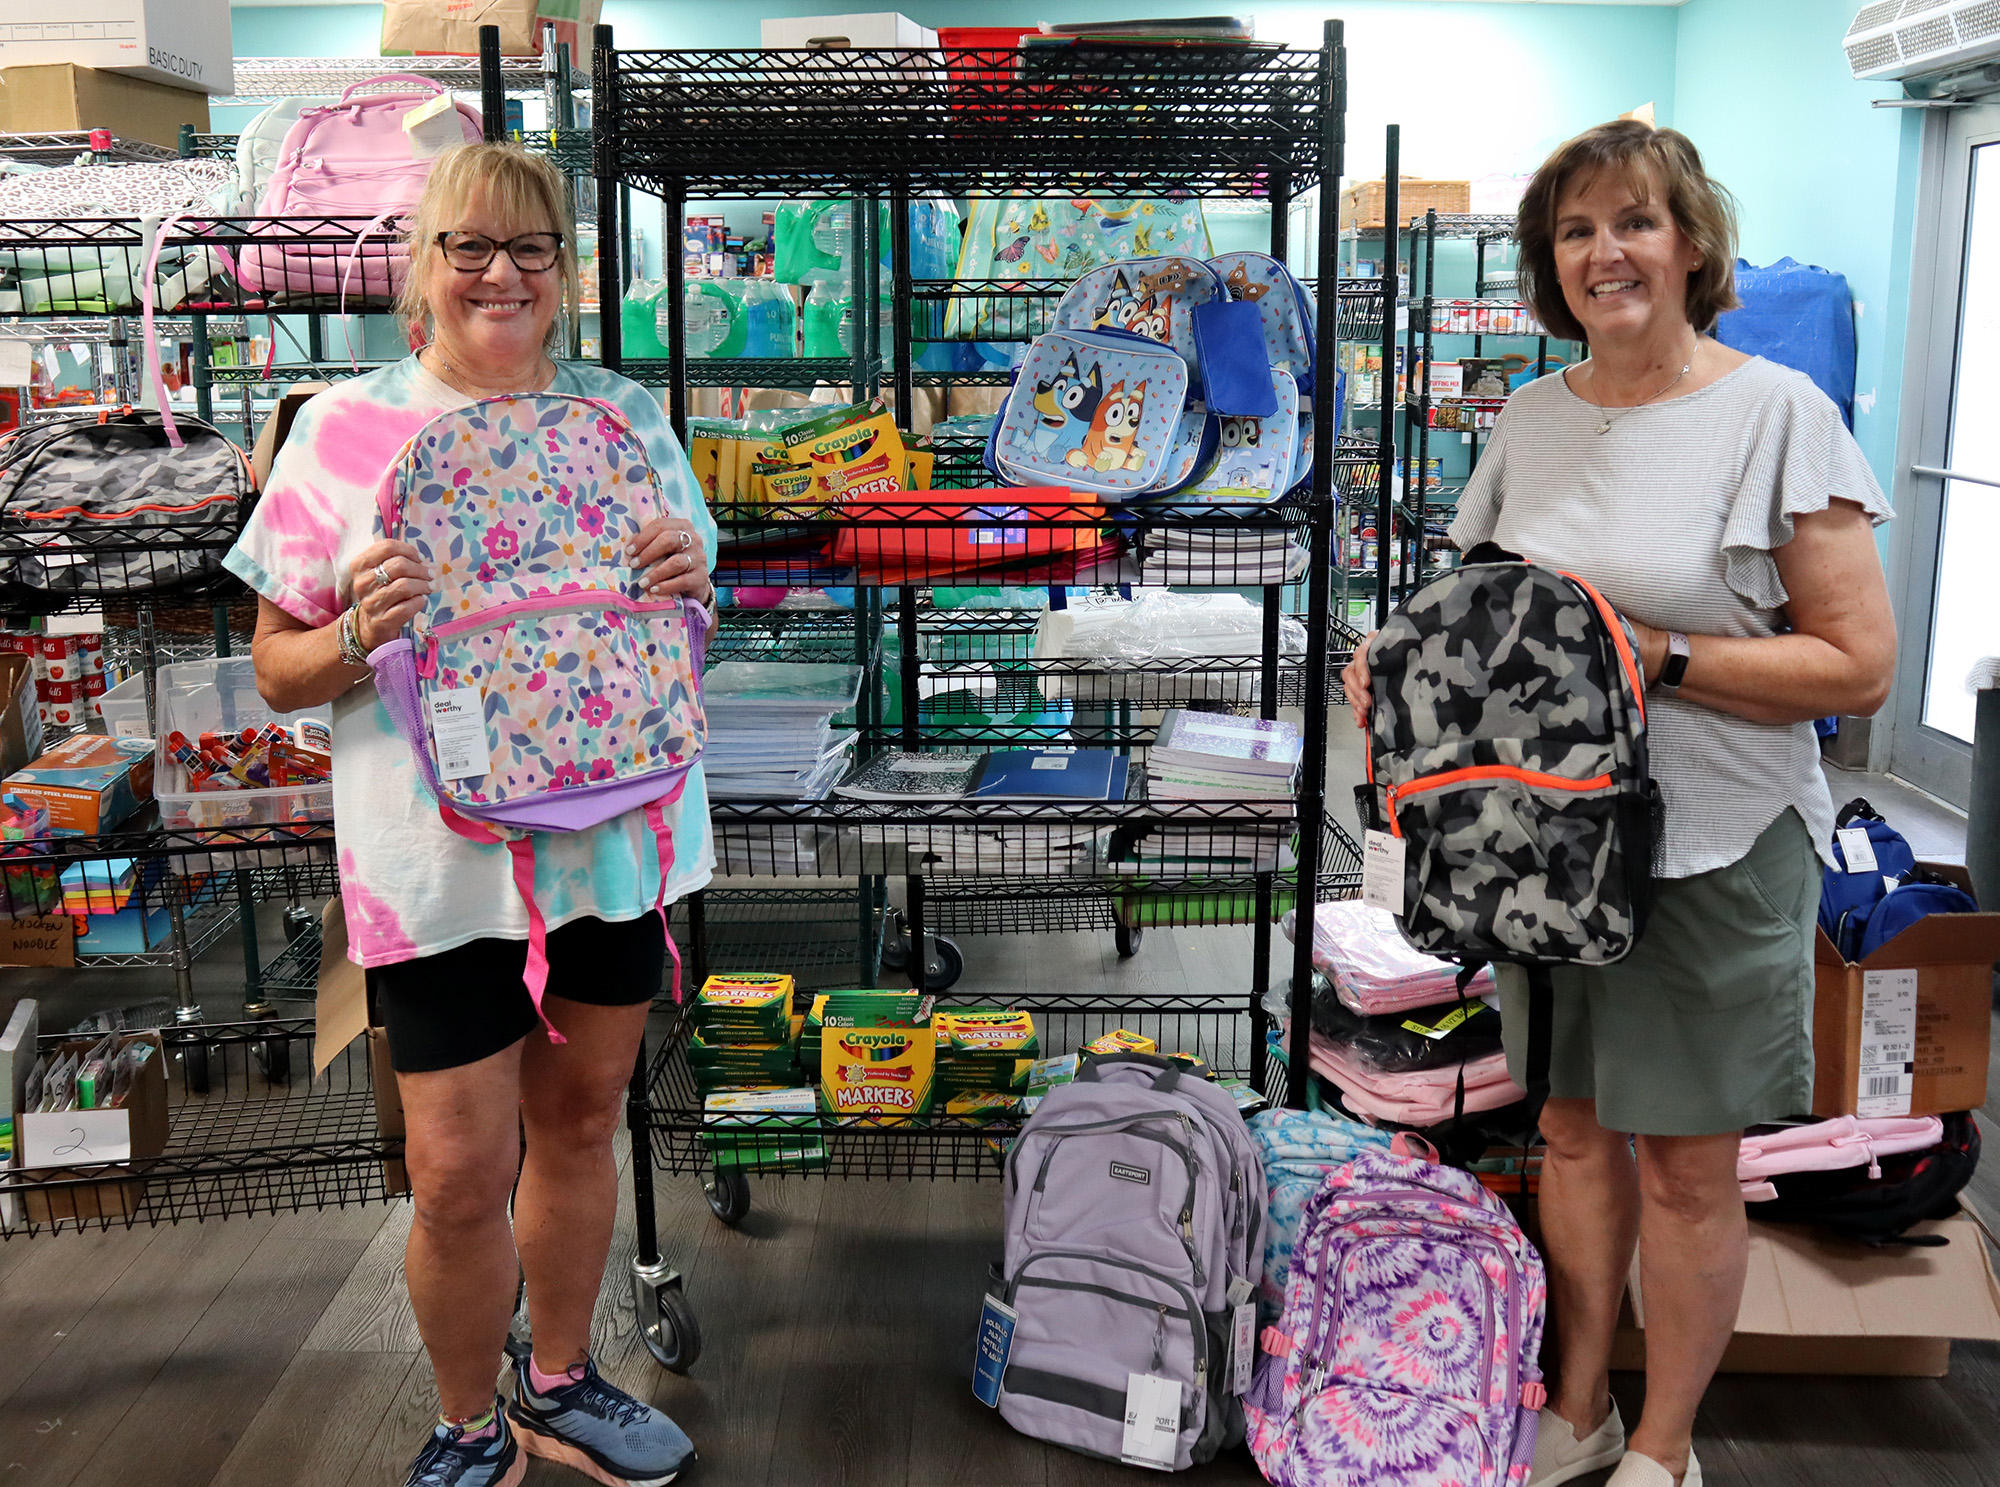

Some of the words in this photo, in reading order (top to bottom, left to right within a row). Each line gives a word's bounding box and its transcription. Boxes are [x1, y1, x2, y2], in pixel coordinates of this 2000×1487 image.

[150, 47, 177, 72] BASIC
[179, 57, 203, 80] DUTY
[695, 430, 707, 438] 10
[785, 434, 798, 446] 10
[798, 428, 815, 437] Classic
[800, 433, 816, 442] Colors
[814, 427, 873, 454] Crayola
[774, 474, 808, 485] Crayola
[434, 700, 451, 708] deal
[435, 705, 462, 714] worthy
[9, 787, 42, 795] STAINLESS
[43, 790, 61, 798] STEEL
[1368, 845, 1389, 855] worthy
[13, 938, 59, 950] NOODLE
[706, 990, 775, 999] MARKERS
[824, 1016, 837, 1026] 10
[845, 1033, 905, 1048] Crayola
[958, 1032, 1028, 1040] MARKERS
[837, 1087, 914, 1107] MARKERS
[53, 1128, 92, 1155] 2
[1114, 1167, 1145, 1179] EASTSPORT
[985, 1318, 1008, 1338] BOLSILLO
[988, 1329, 1002, 1343] PARA
[983, 1336, 1004, 1355] BOTELLA
[982, 1345, 988, 1354] DE
[988, 1352, 1002, 1363] AGUA
